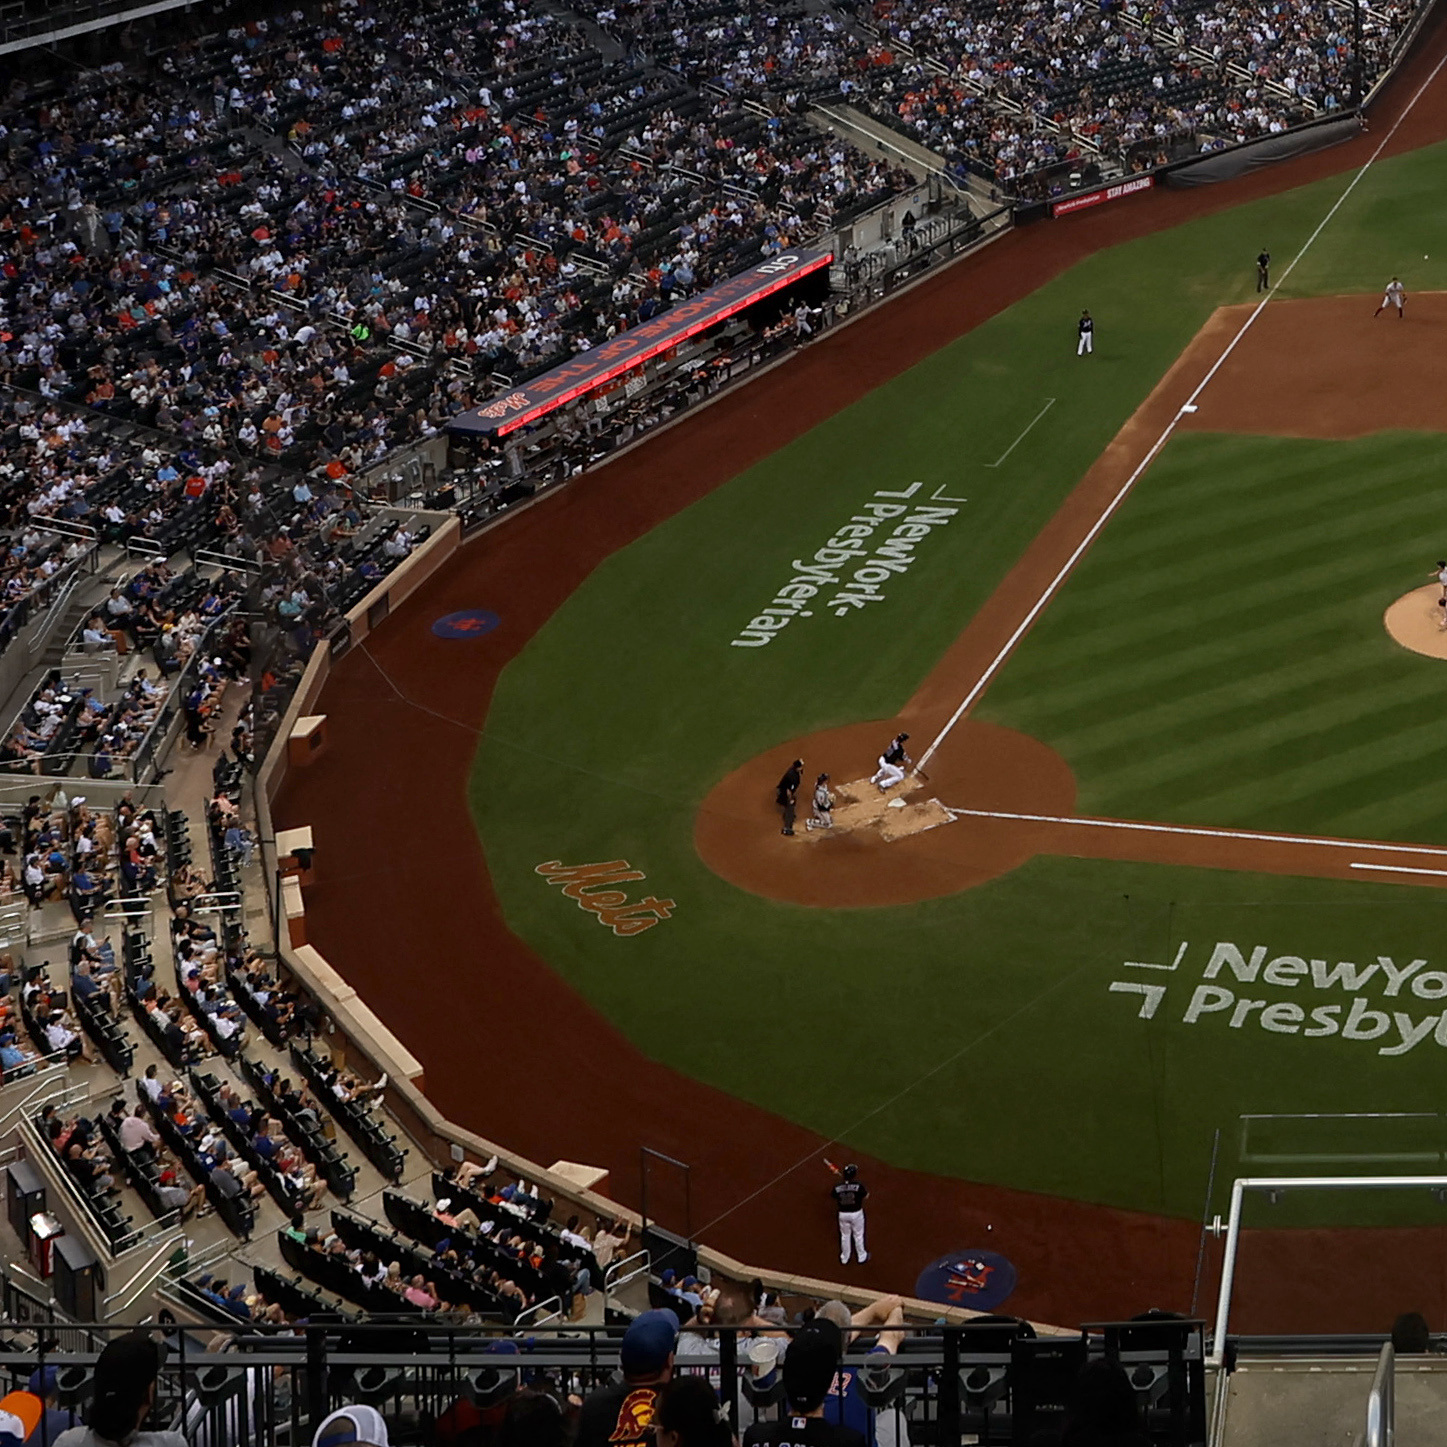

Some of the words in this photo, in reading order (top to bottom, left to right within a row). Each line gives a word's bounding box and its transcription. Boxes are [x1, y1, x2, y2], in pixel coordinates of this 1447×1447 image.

[756, 255, 799, 274] citi
[526, 362, 598, 393] THE
[730, 503, 908, 648] Presbyterian
[534, 860, 677, 936] Mets
